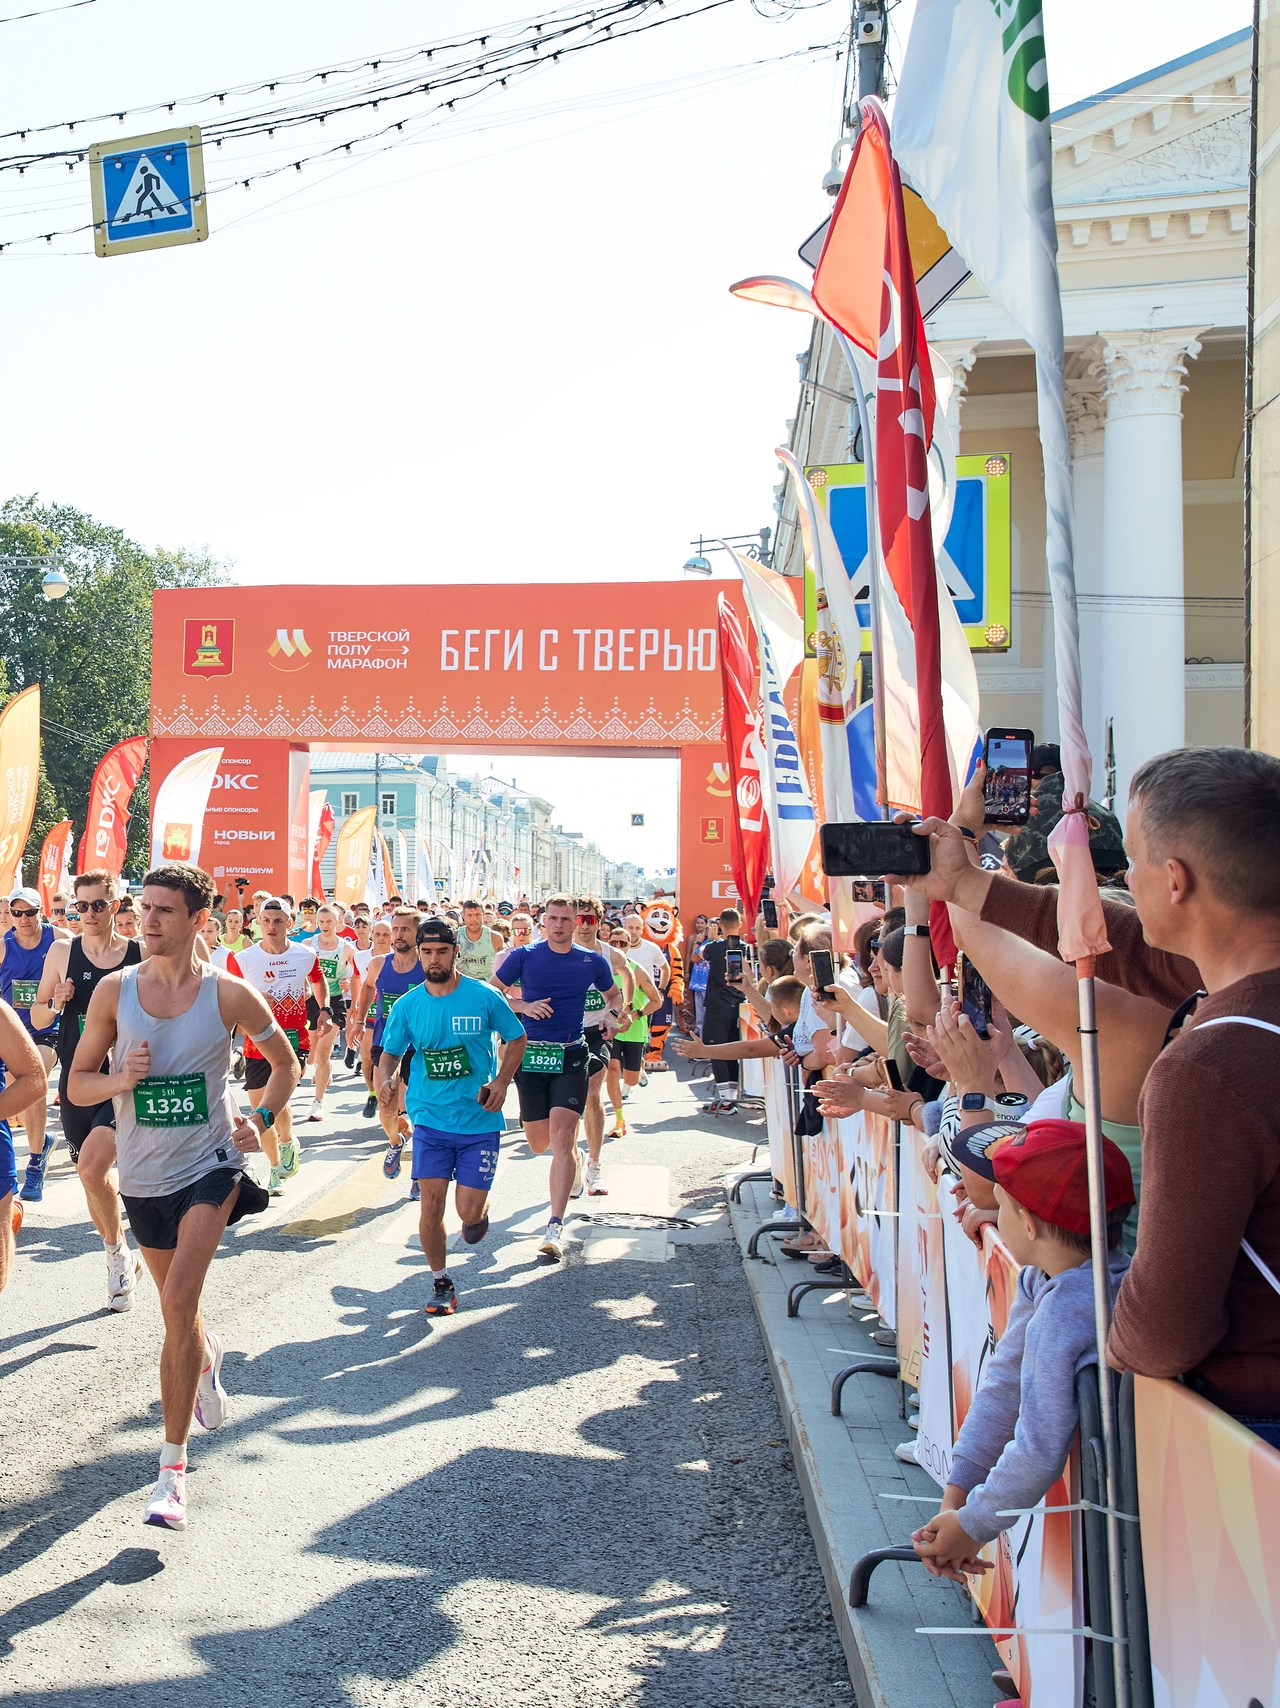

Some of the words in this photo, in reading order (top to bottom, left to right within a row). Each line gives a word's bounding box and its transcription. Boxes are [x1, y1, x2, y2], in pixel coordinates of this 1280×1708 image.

[327, 628, 410, 642] ТВЕРСКОЙ
[327, 644, 372, 656] ПОЛУ
[440, 628, 524, 672] БЕГИ
[538, 628, 559, 672] С
[573, 628, 717, 672] ТВЕРЬЮ
[327, 657, 408, 671] МАРАФОН
[221, 758, 252, 766] спонсор
[17, 765, 30, 823] МАРАФОН
[98, 775, 121, 829] DKC
[213, 830, 276, 841] НОВЫЙ
[225, 866, 274, 874] ИЛЛИДИУМ
[19, 992, 38, 1002] 131
[431, 1060, 462, 1073] 1776
[530, 1055, 557, 1066] 1820
[146, 1096, 195, 1114] 1326
